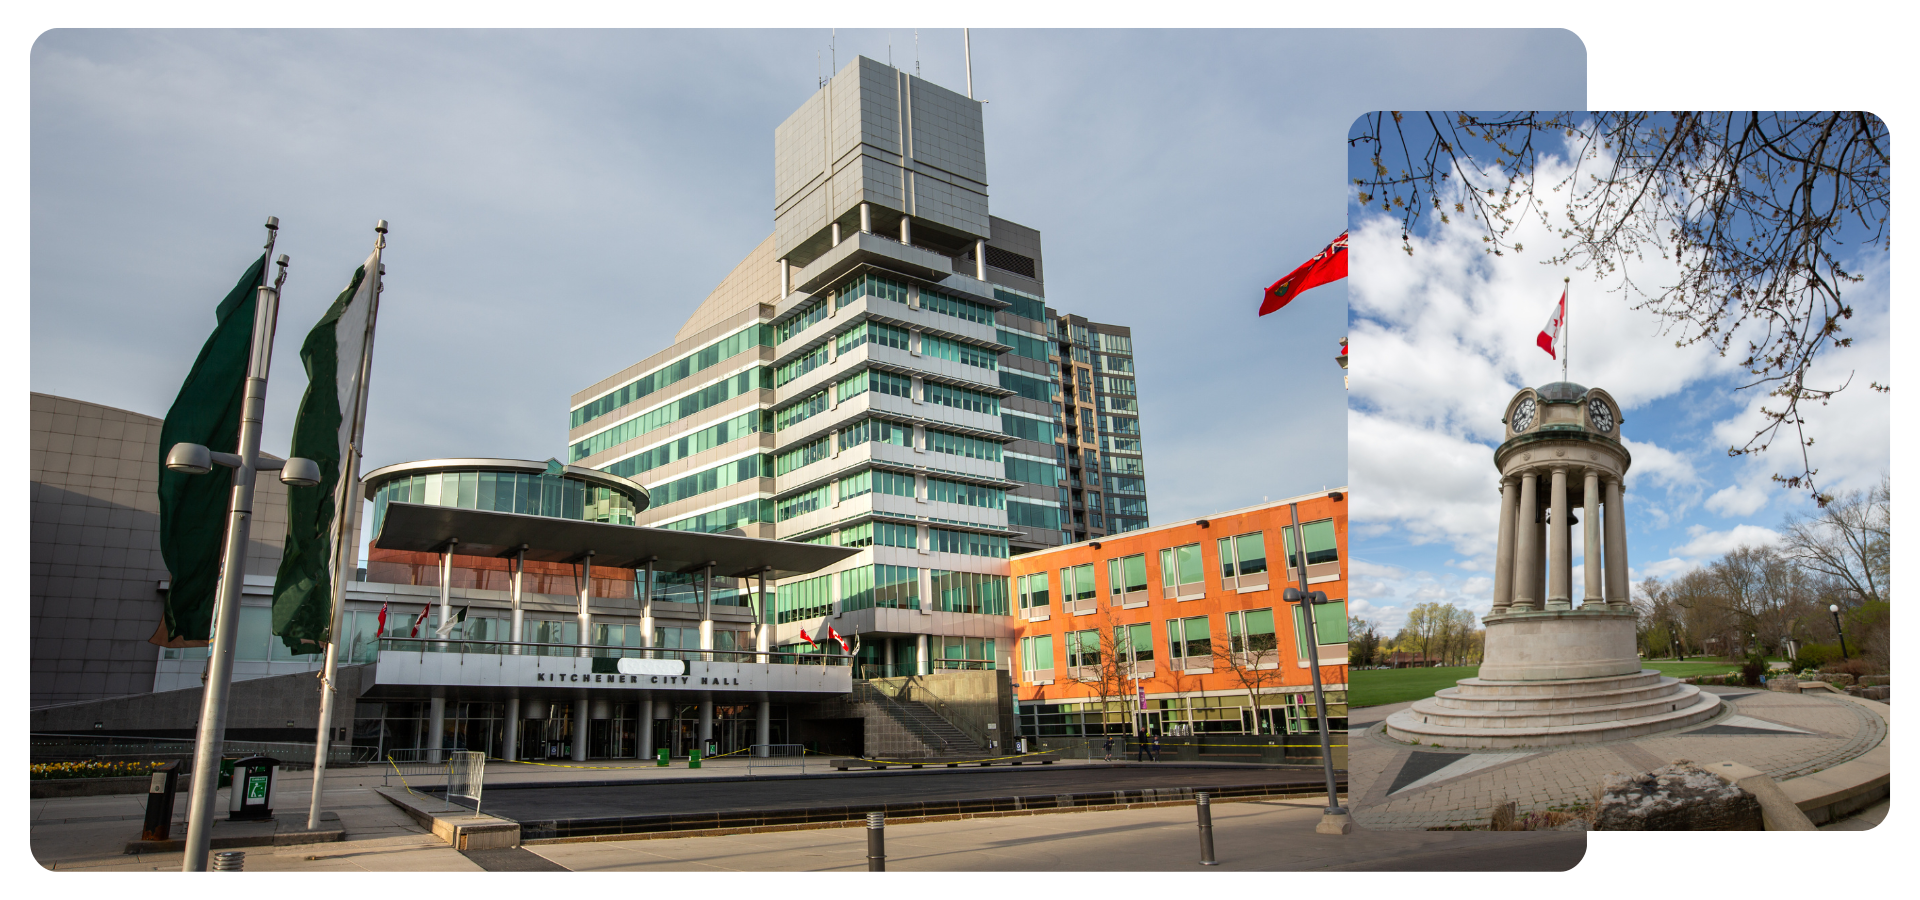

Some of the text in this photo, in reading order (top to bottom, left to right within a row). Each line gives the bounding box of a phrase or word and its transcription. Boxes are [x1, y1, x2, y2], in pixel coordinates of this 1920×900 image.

[537, 673, 739, 685] KITCHENER CITY HALL
